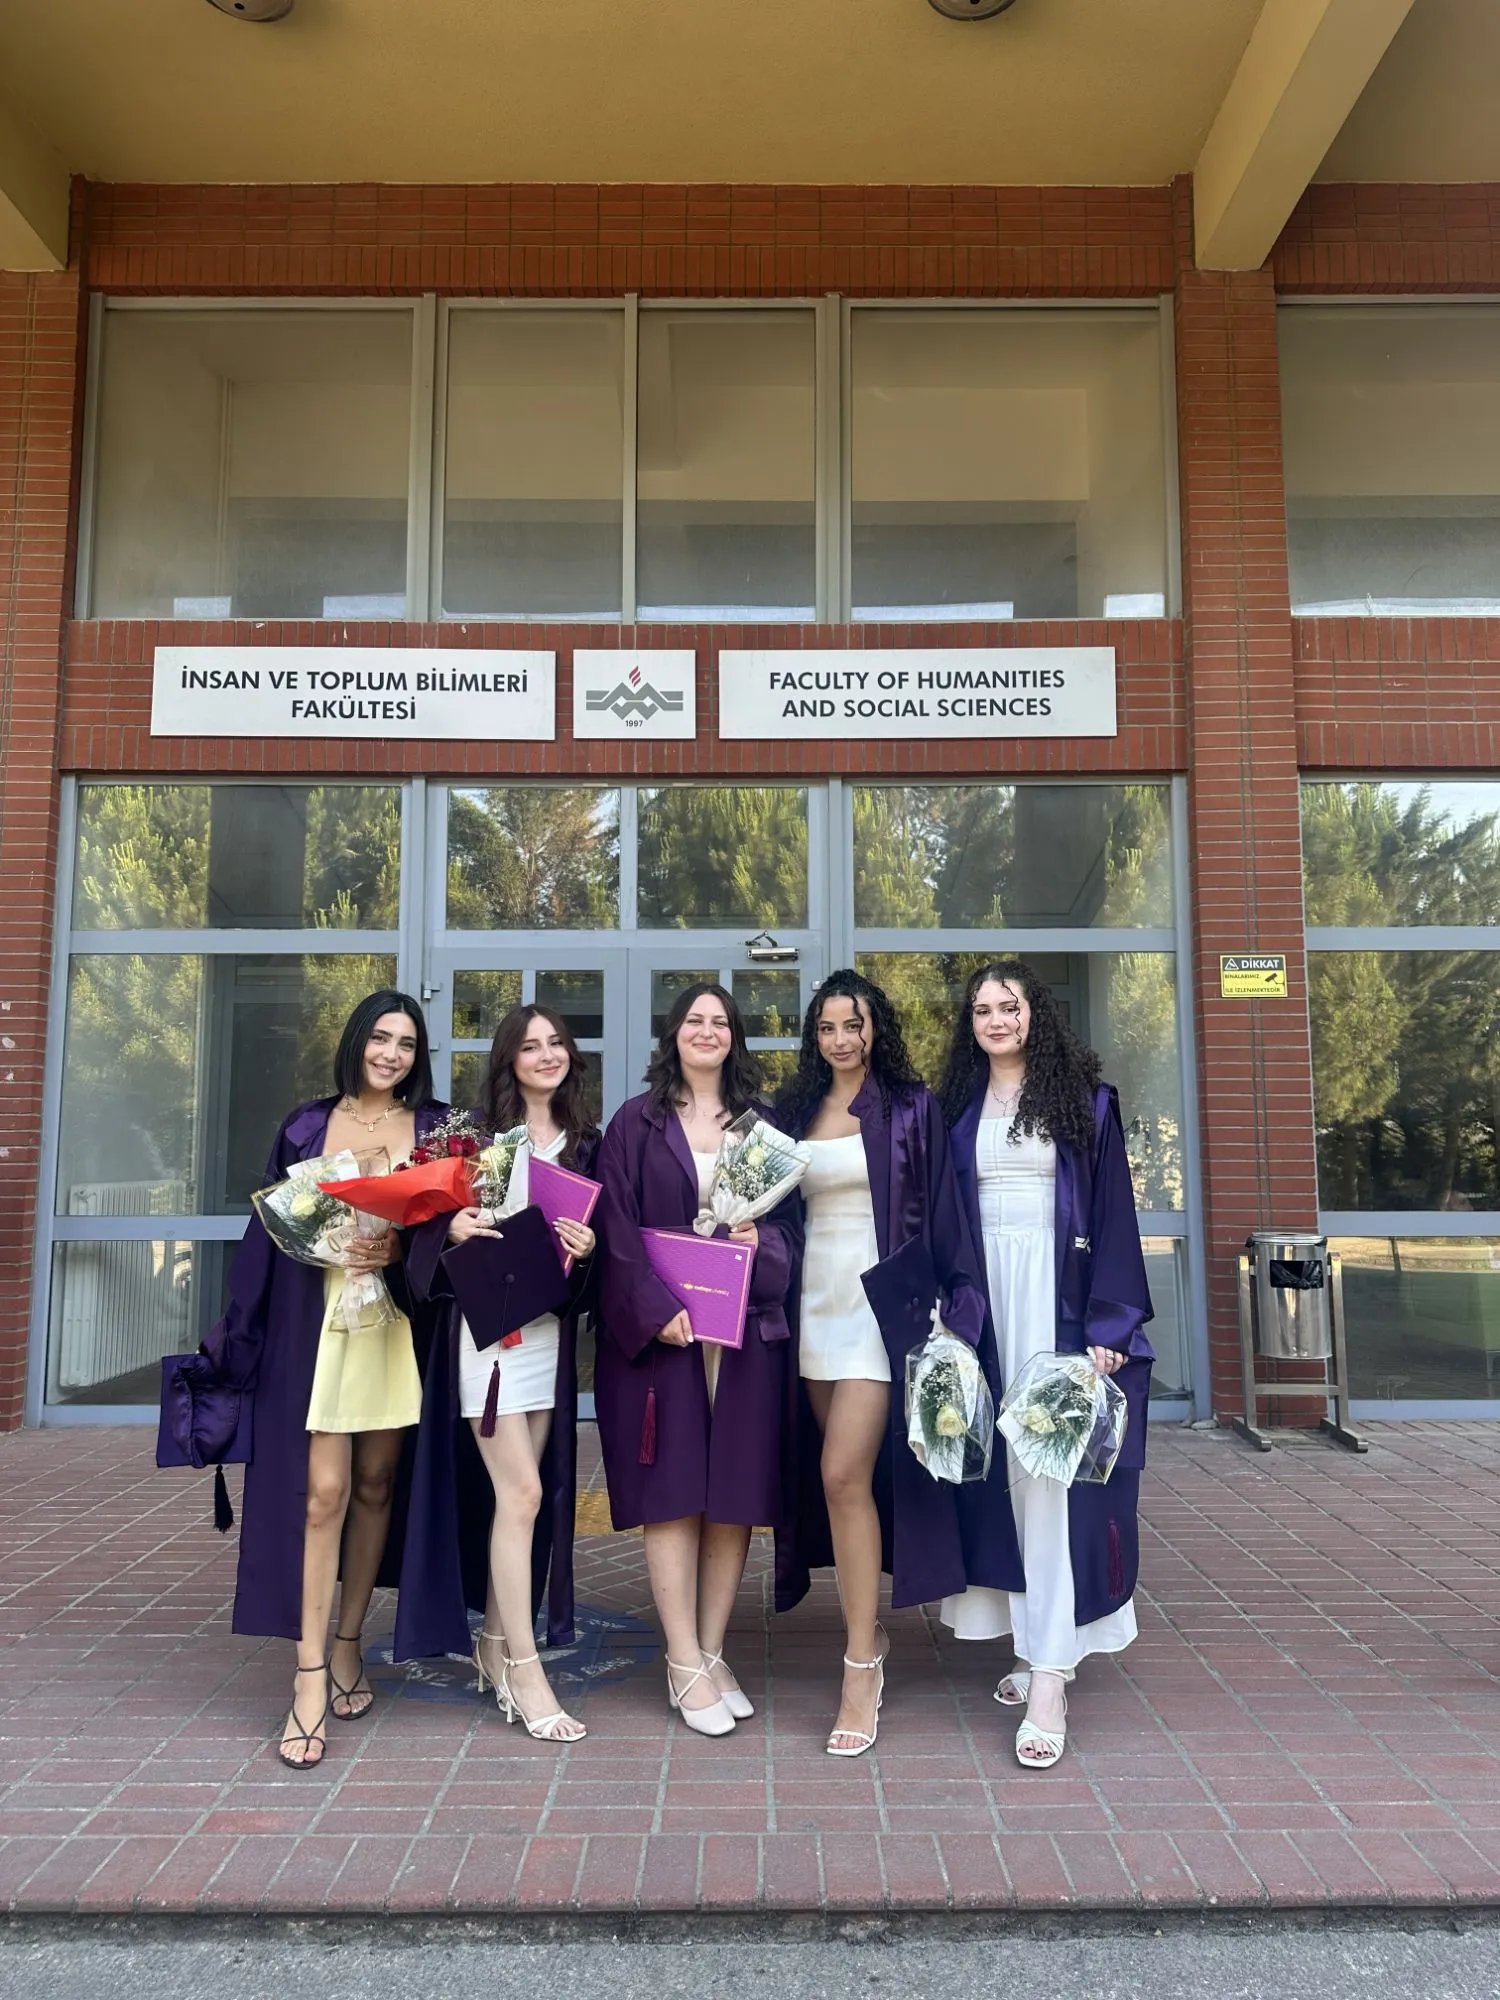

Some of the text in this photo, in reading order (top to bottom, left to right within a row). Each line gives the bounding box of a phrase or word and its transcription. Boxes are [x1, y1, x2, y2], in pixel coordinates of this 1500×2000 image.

[181, 665, 528, 693] İNSAN VE TOPLUM BİLİMLERİ
[770, 669, 1065, 690] FACULTY OF HUMANITIES
[291, 695, 416, 720] FAKÜLTESİ
[782, 697, 1052, 718] AND SOCIAL SCIENCES
[1241, 957, 1280, 969] DİKKAT
